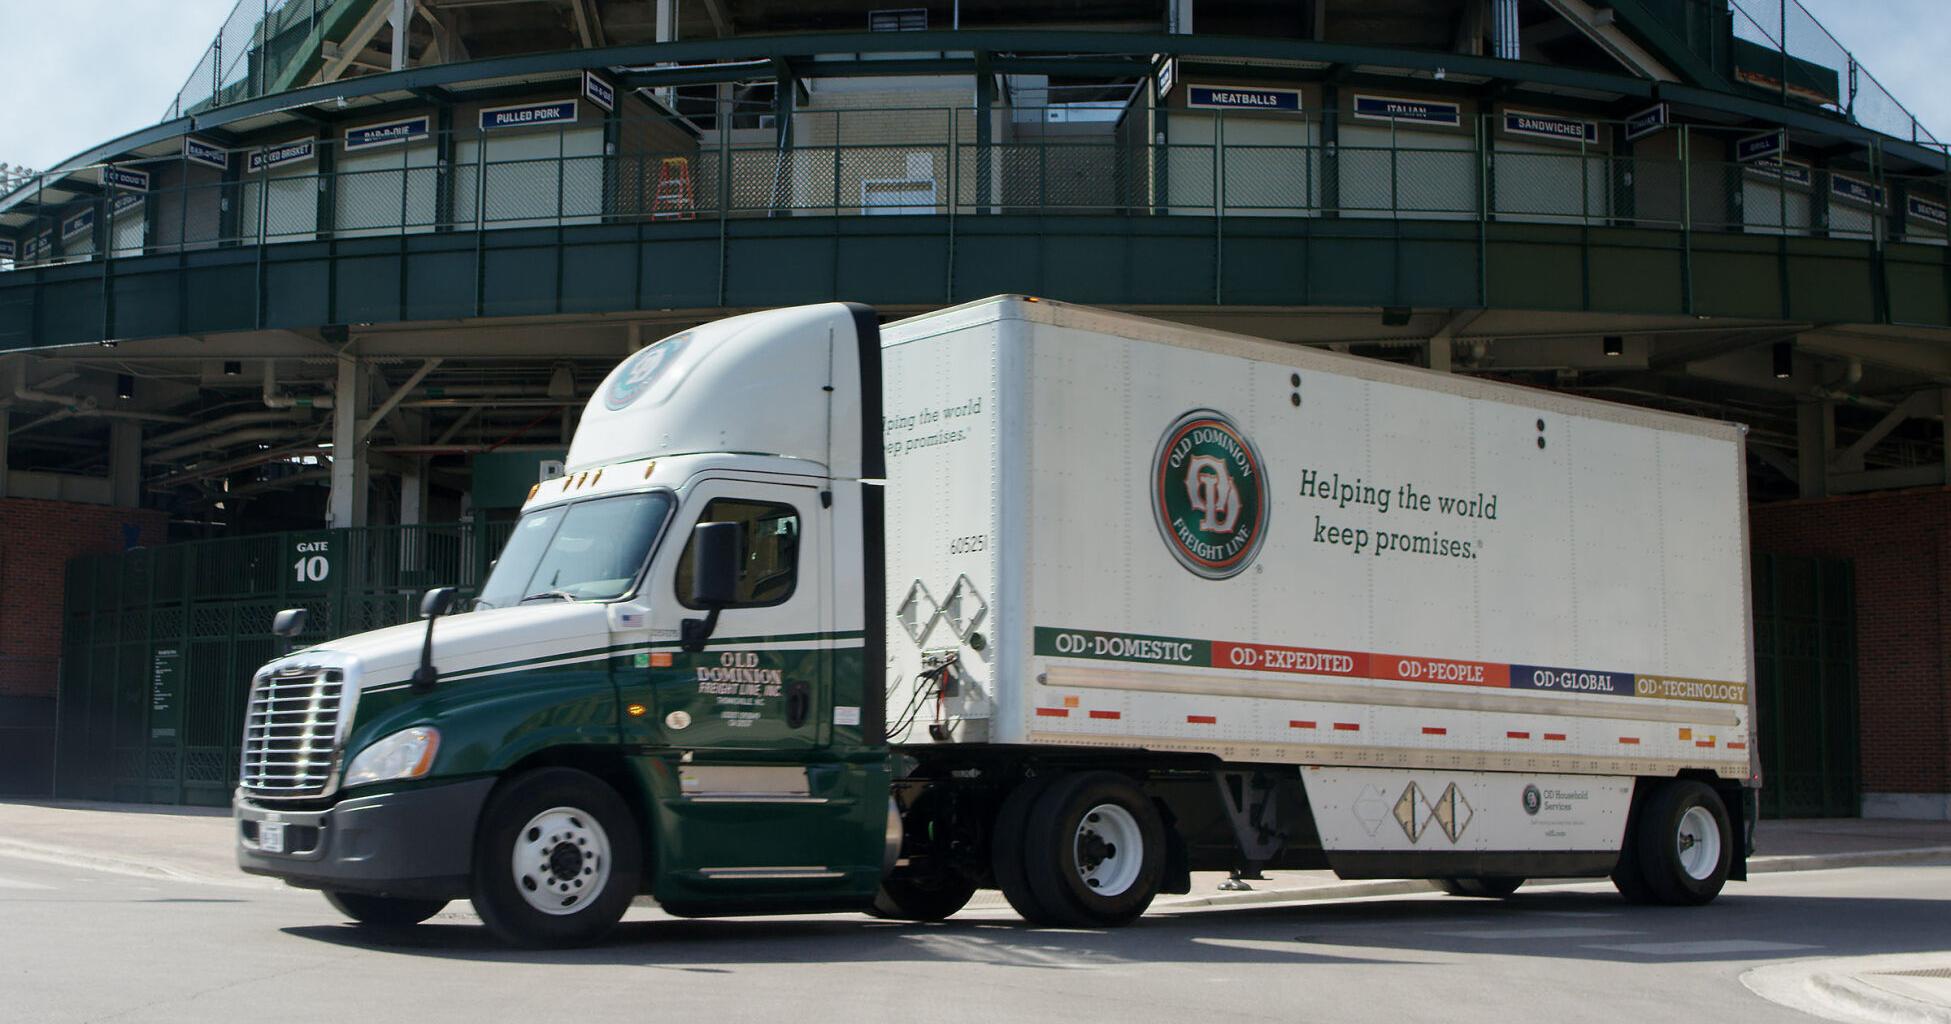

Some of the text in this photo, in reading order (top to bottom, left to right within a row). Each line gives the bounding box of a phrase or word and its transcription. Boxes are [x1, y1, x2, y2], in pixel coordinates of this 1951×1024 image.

[1211, 92, 1277, 106] MEATBALLS
[496, 108, 560, 124] PULLED PORK
[1517, 118, 1583, 137] SANDWICHES
[920, 407, 939, 424] the
[943, 397, 982, 418] world
[1169, 428, 1253, 478] OLD DOMINION
[1299, 468, 1498, 520] Helping the world
[1172, 518, 1250, 560] FREIGHT LINE
[1313, 515, 1369, 554] keep
[296, 541, 329, 552] GATE
[294, 555, 330, 583] 10
[720, 651, 759, 668] OLD
[696, 667, 783, 685] DOMINION
